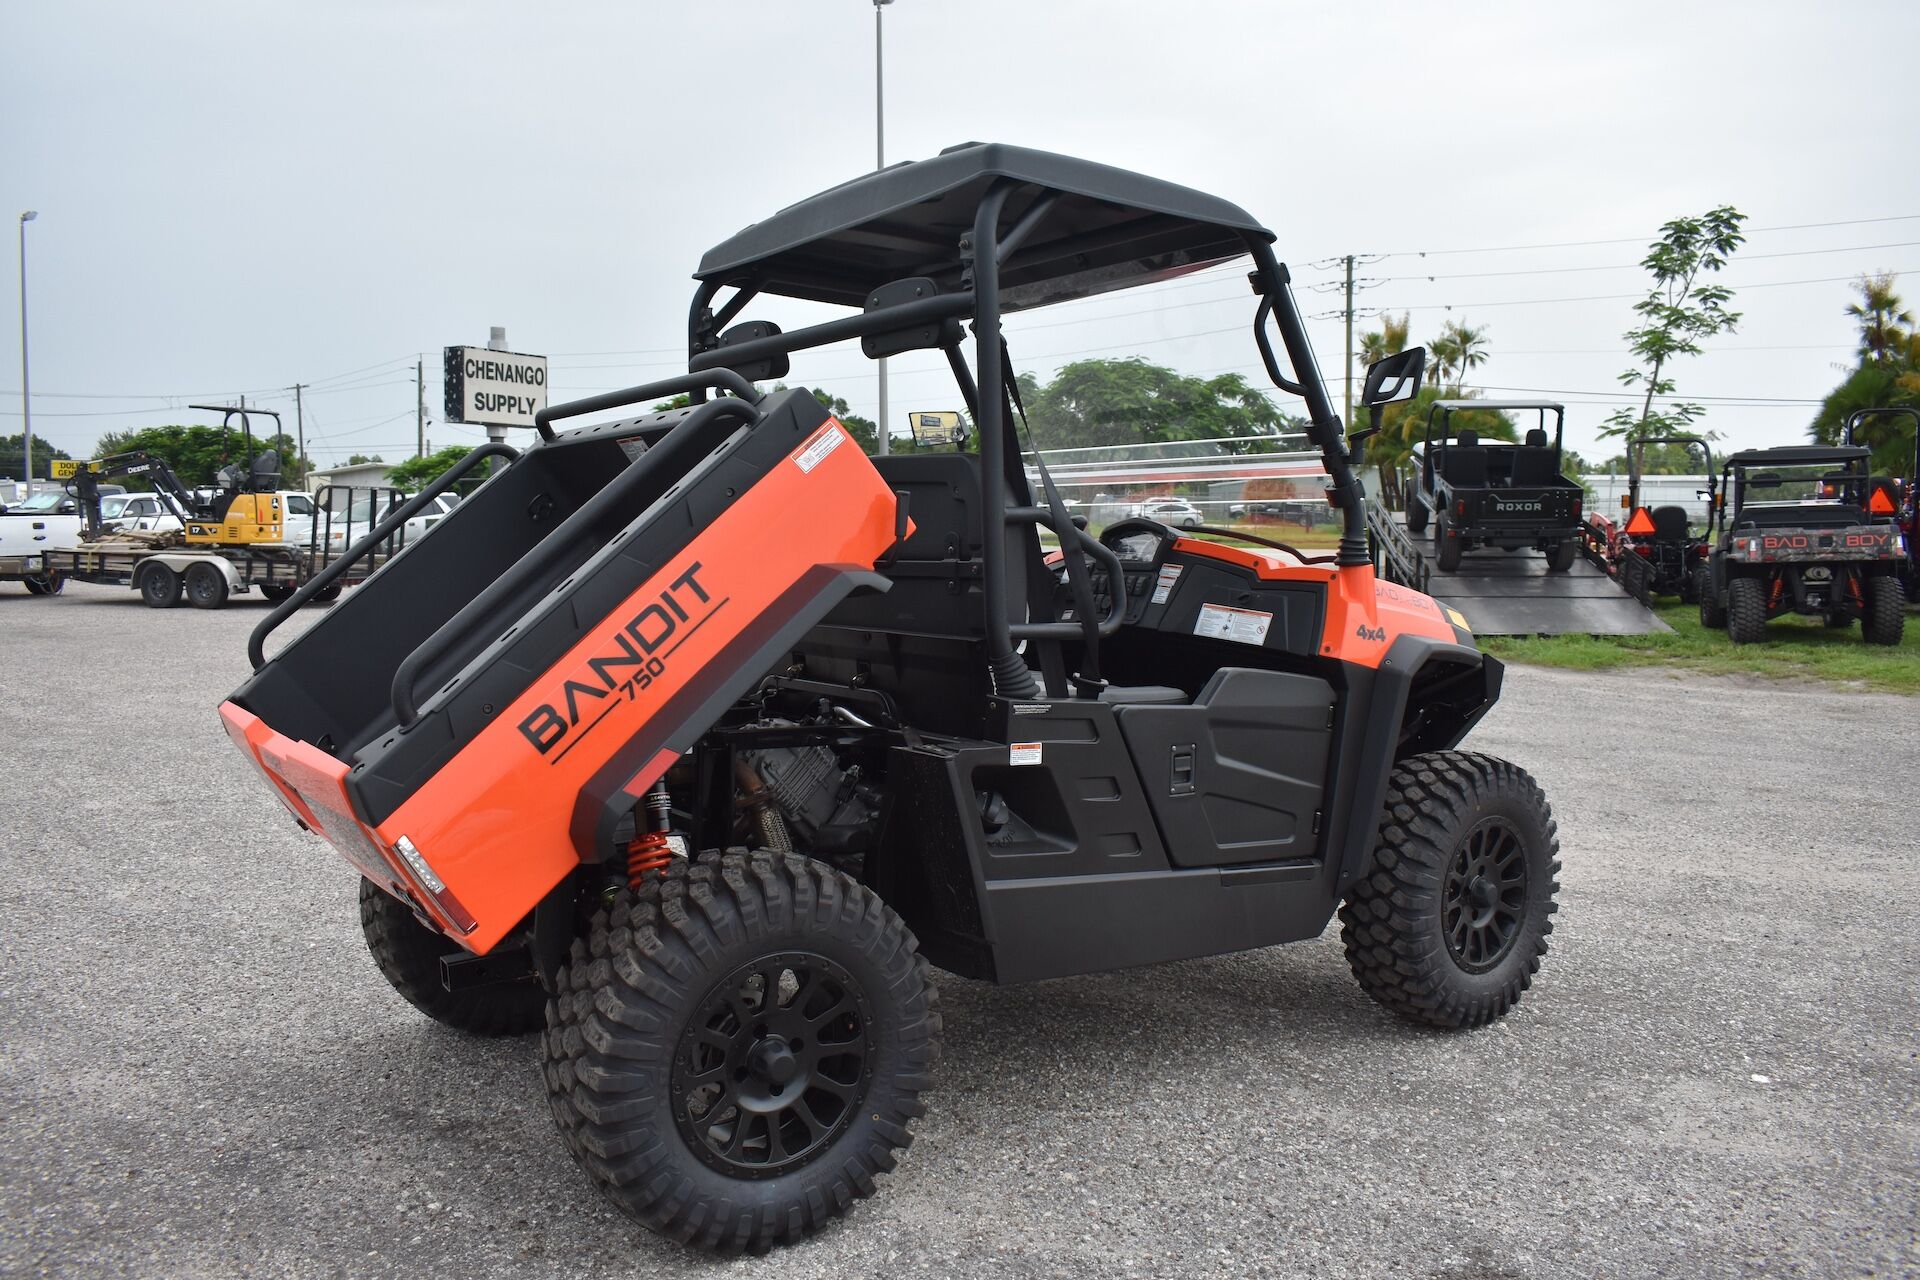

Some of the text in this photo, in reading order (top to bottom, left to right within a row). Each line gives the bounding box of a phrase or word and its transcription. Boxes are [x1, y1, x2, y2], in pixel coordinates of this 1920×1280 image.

[465, 358, 545, 386] CHENANGO
[474, 391, 536, 416] SUPPLY
[127, 464, 150, 474] DEERE
[1496, 503, 1542, 511] ROXOR
[1763, 534, 1889, 549] BAD BOY
[1356, 624, 1386, 642] 4x4
[516, 560, 711, 756] BANDIT
[618, 656, 666, 702] 750
